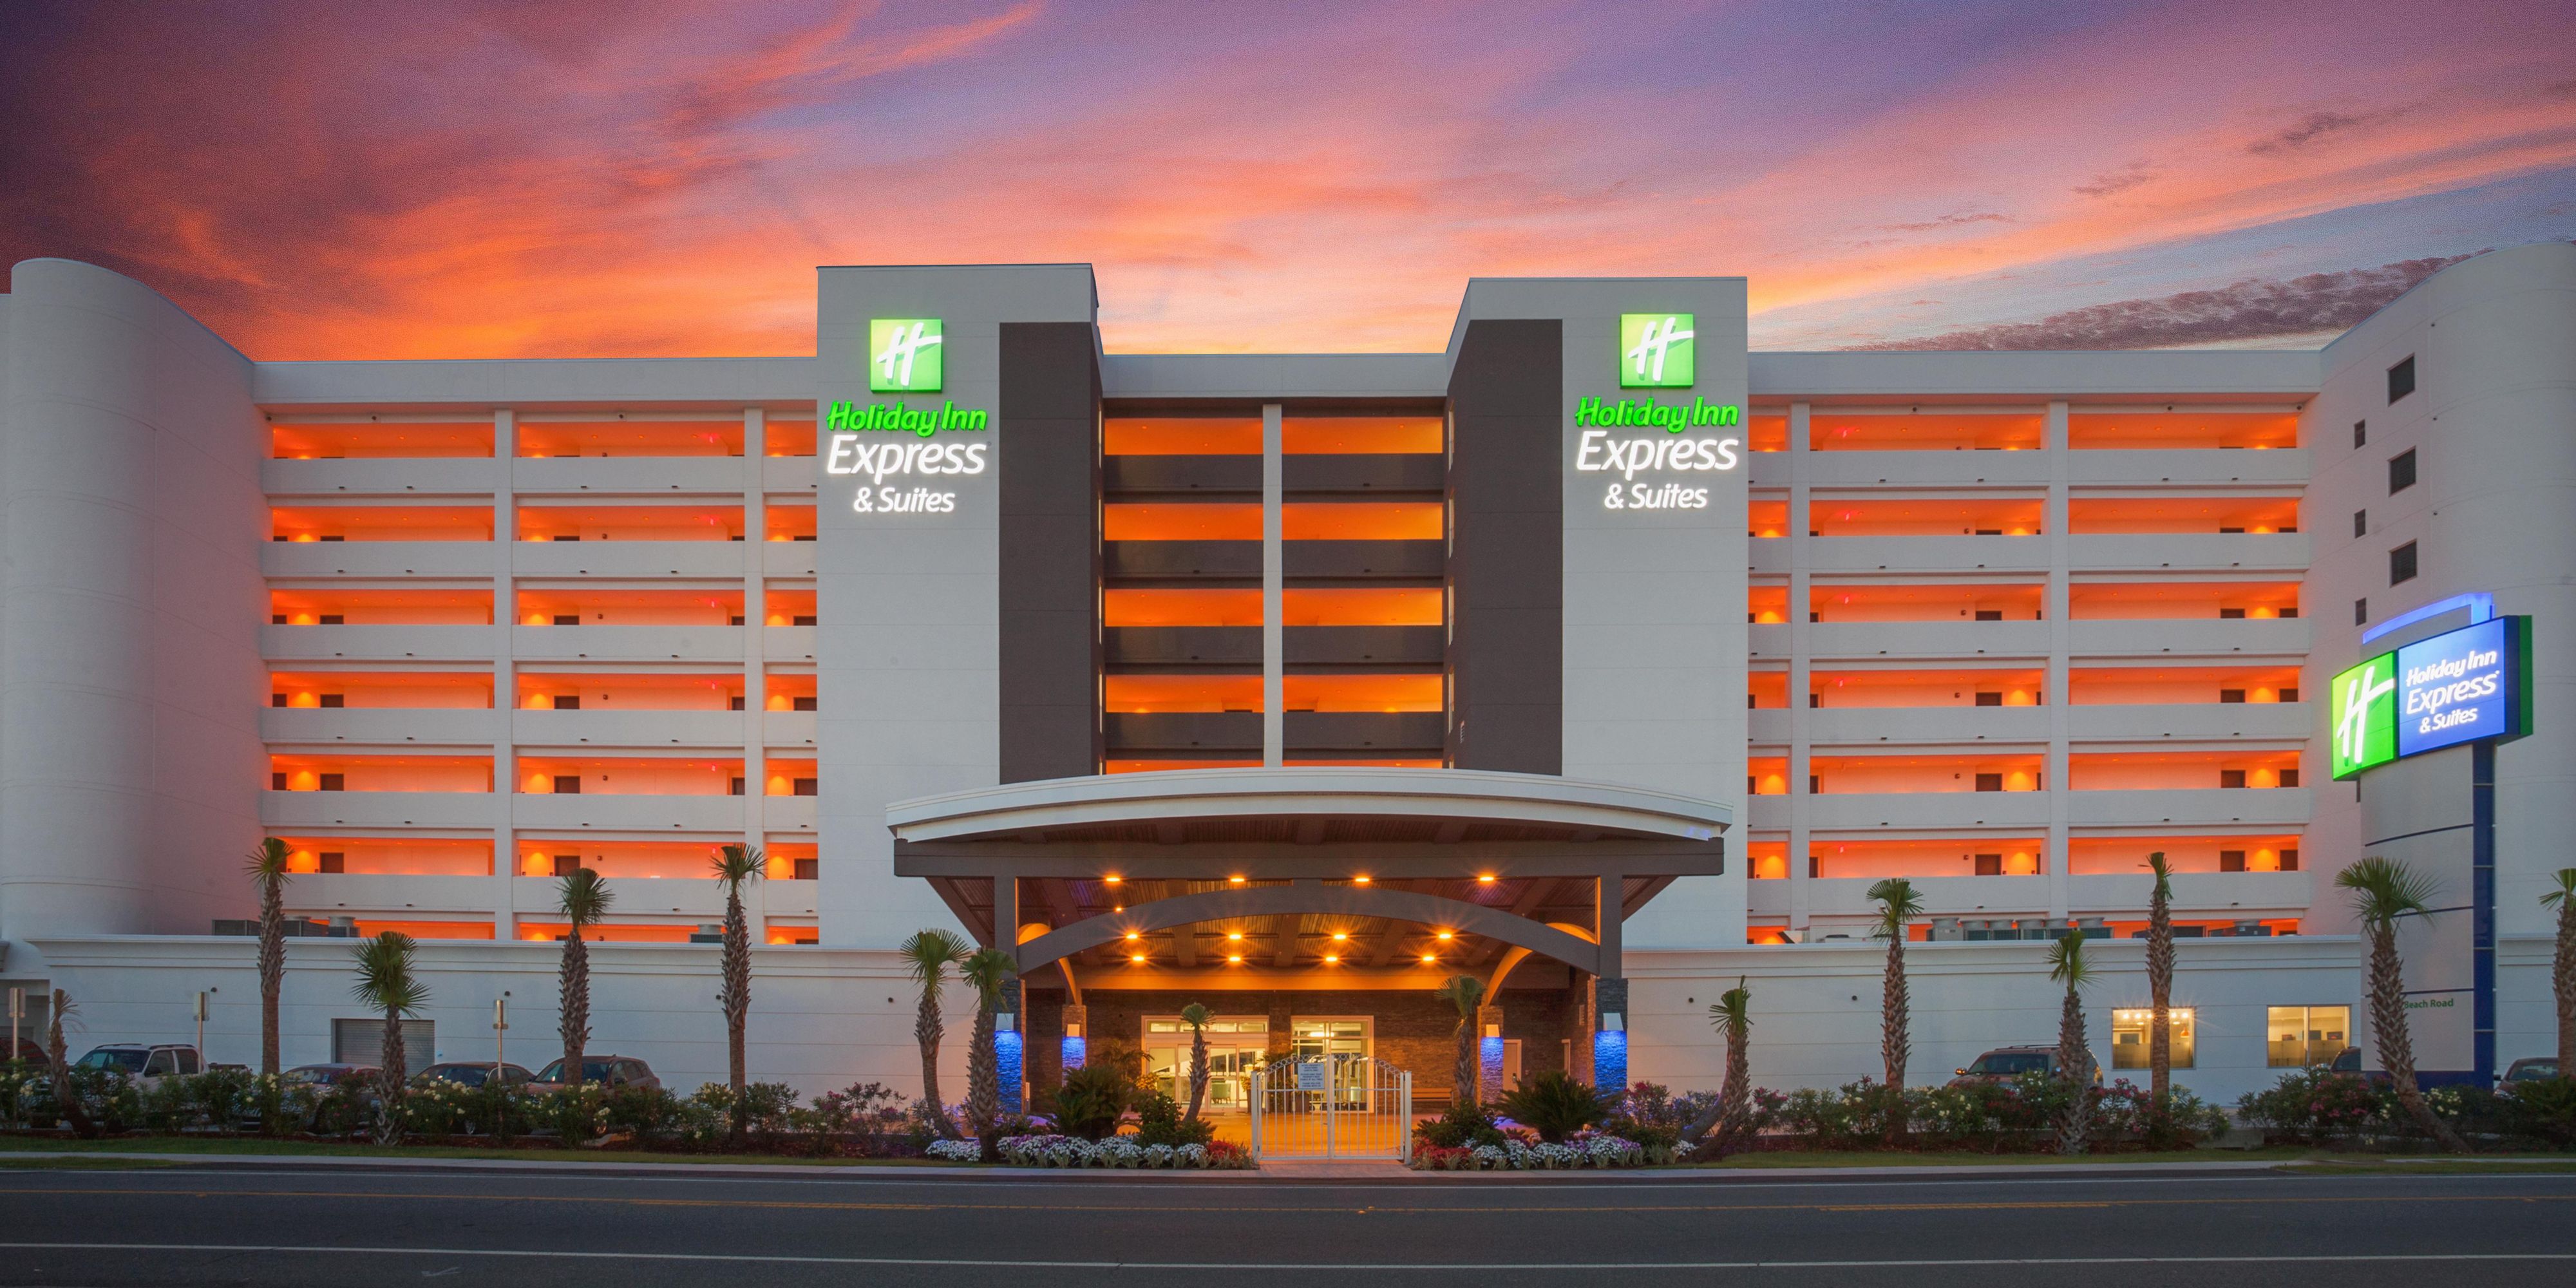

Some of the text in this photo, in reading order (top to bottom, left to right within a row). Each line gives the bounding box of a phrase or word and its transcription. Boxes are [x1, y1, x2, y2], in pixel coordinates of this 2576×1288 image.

[827, 400, 988, 437] Holiday Inn
[1575, 396, 1739, 433] Holiday Inn
[827, 434, 987, 485] Express
[1577, 430, 1739, 481] Express
[853, 487, 956, 513] & Suites
[1604, 483, 1708, 509] & Suites
[2405, 650, 2497, 687] Holiday Inn
[2405, 673, 2497, 715] Express
[2420, 708, 2478, 734] & Suites
[2404, 998, 2454, 1009] Beach Road
